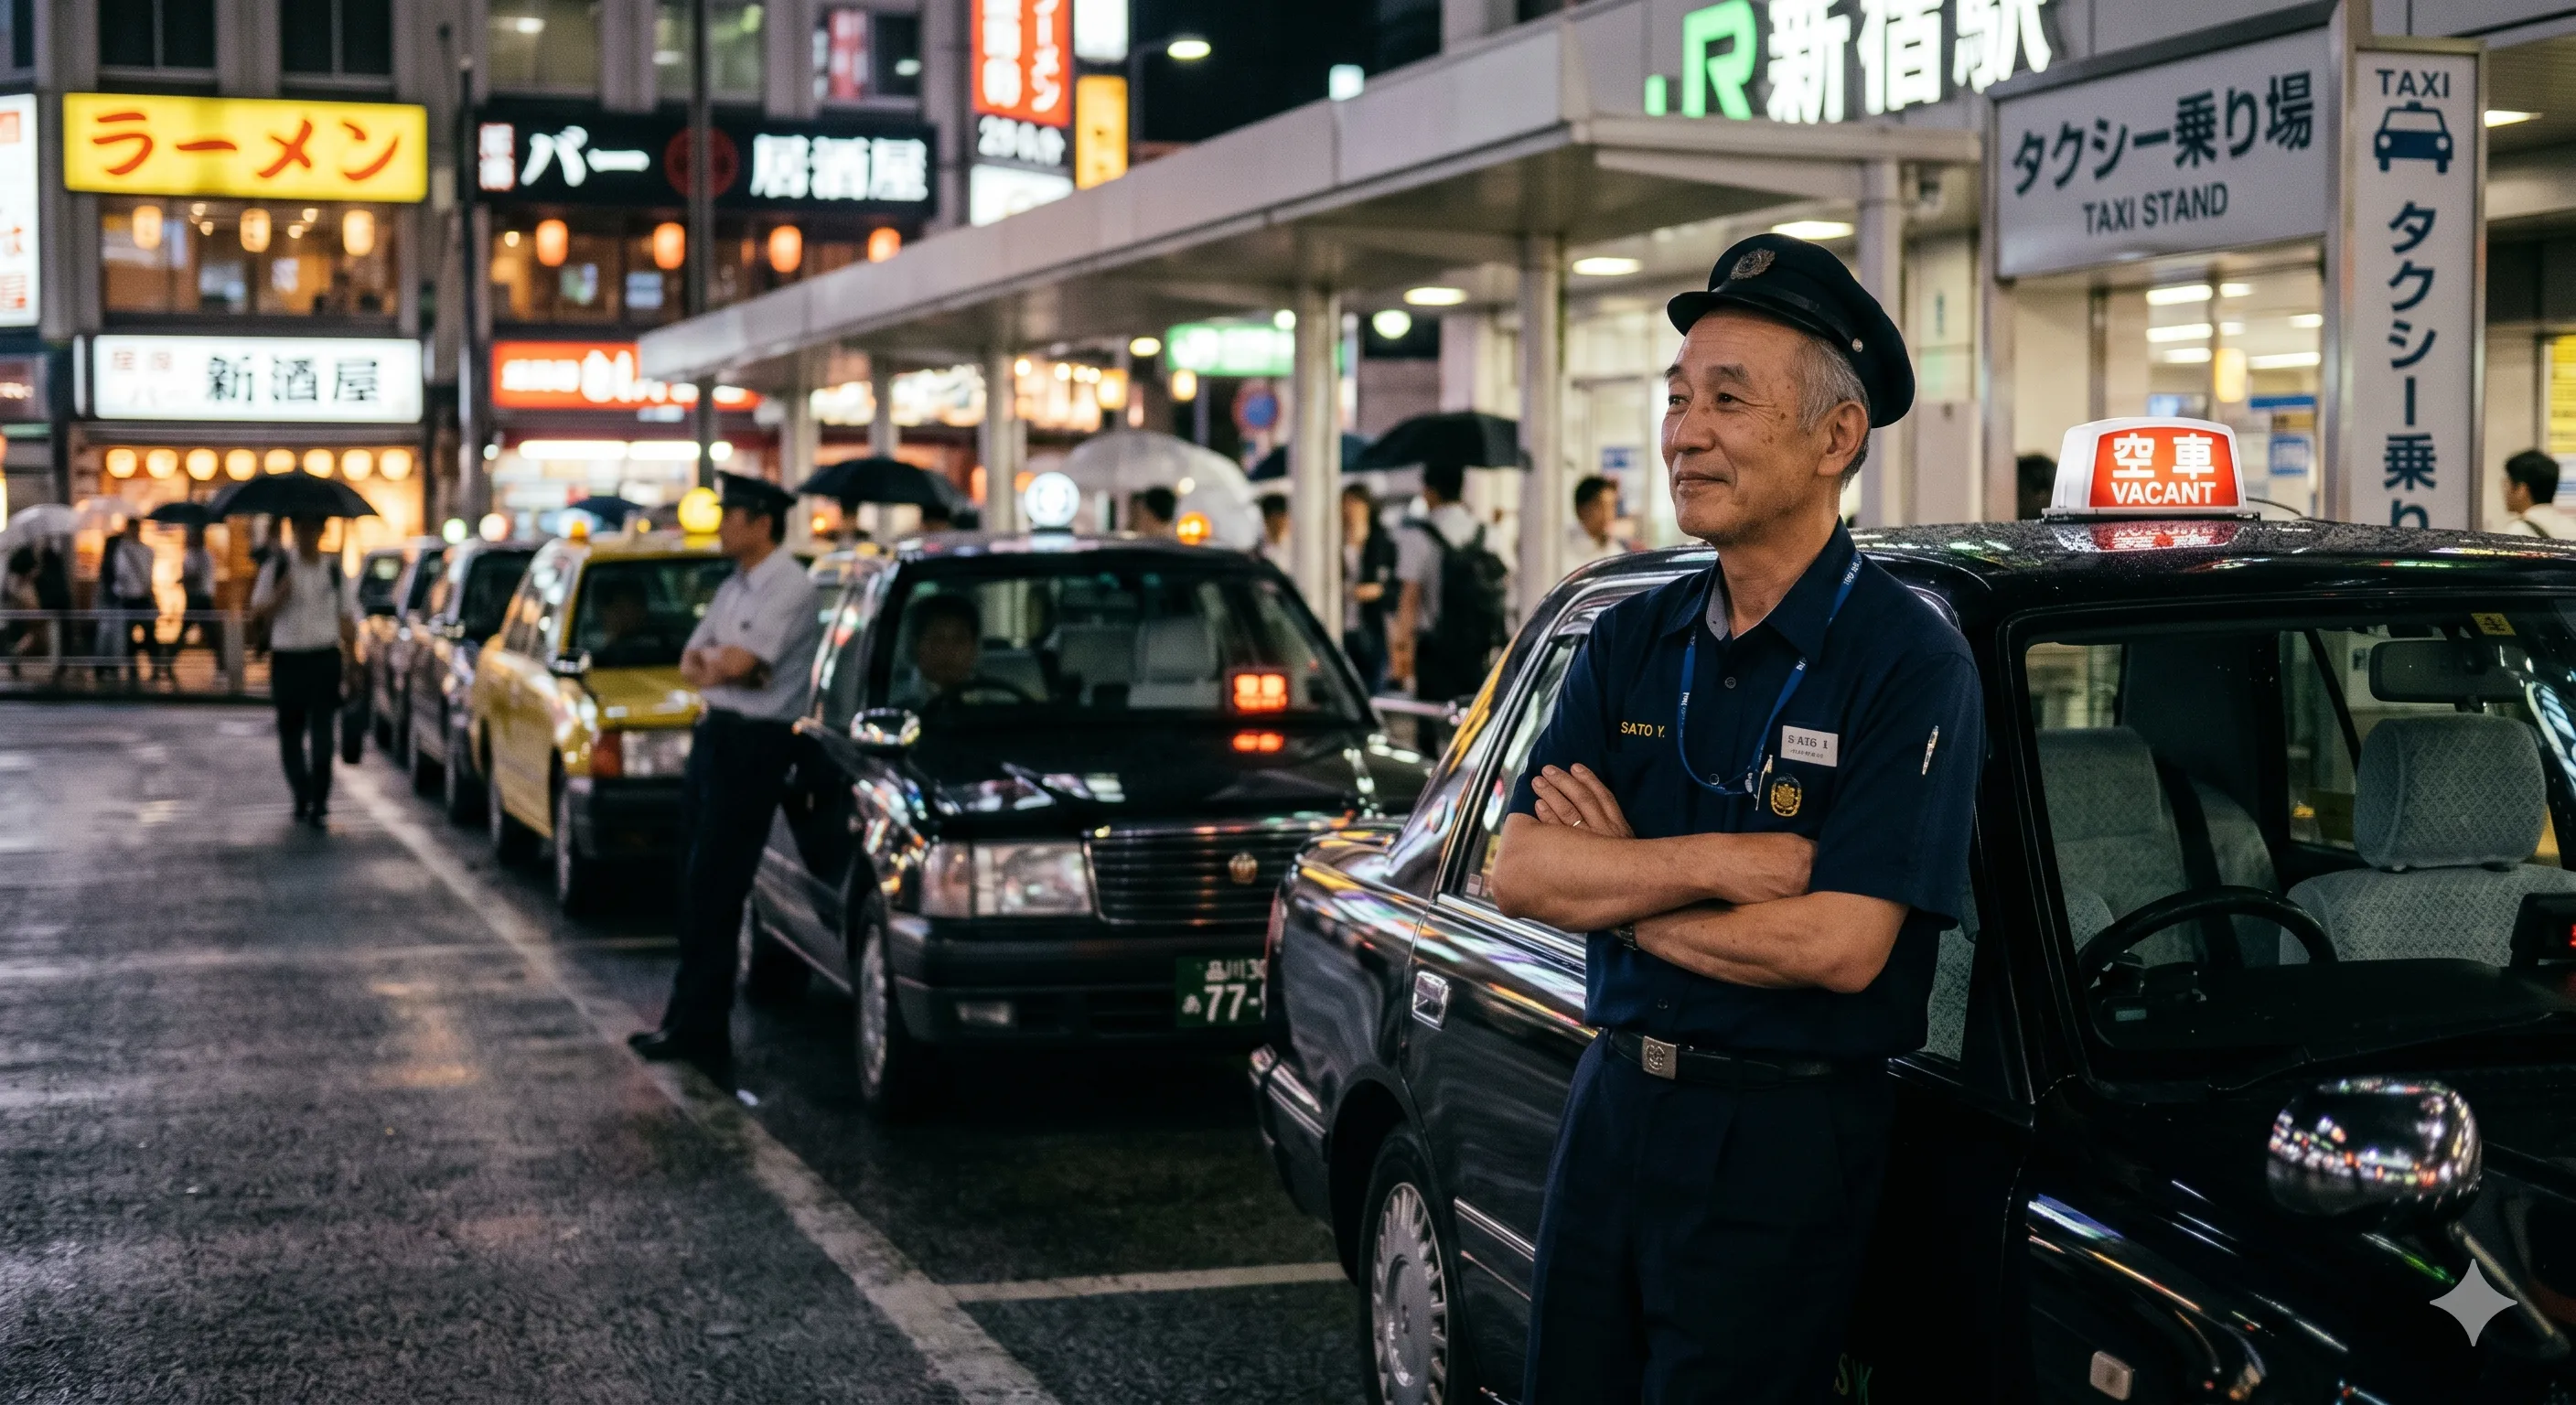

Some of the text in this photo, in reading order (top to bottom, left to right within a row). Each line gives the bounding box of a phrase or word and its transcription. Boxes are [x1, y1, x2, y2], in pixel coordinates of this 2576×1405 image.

[2376, 69, 2451, 99] TAXI
[92, 112, 400, 181] ラーメン
[520, 124, 650, 188] バー
[2012, 70, 2313, 197] タクシー乗り場
[2083, 182, 2228, 235] TAXI STAND
[207, 355, 381, 402] 新酒屋
[2112, 433, 2216, 480] 空車
[2110, 481, 2216, 505] VACANT
[1621, 721, 1665, 738] SATO Y.
[1204, 982, 1268, 1024] 77-
